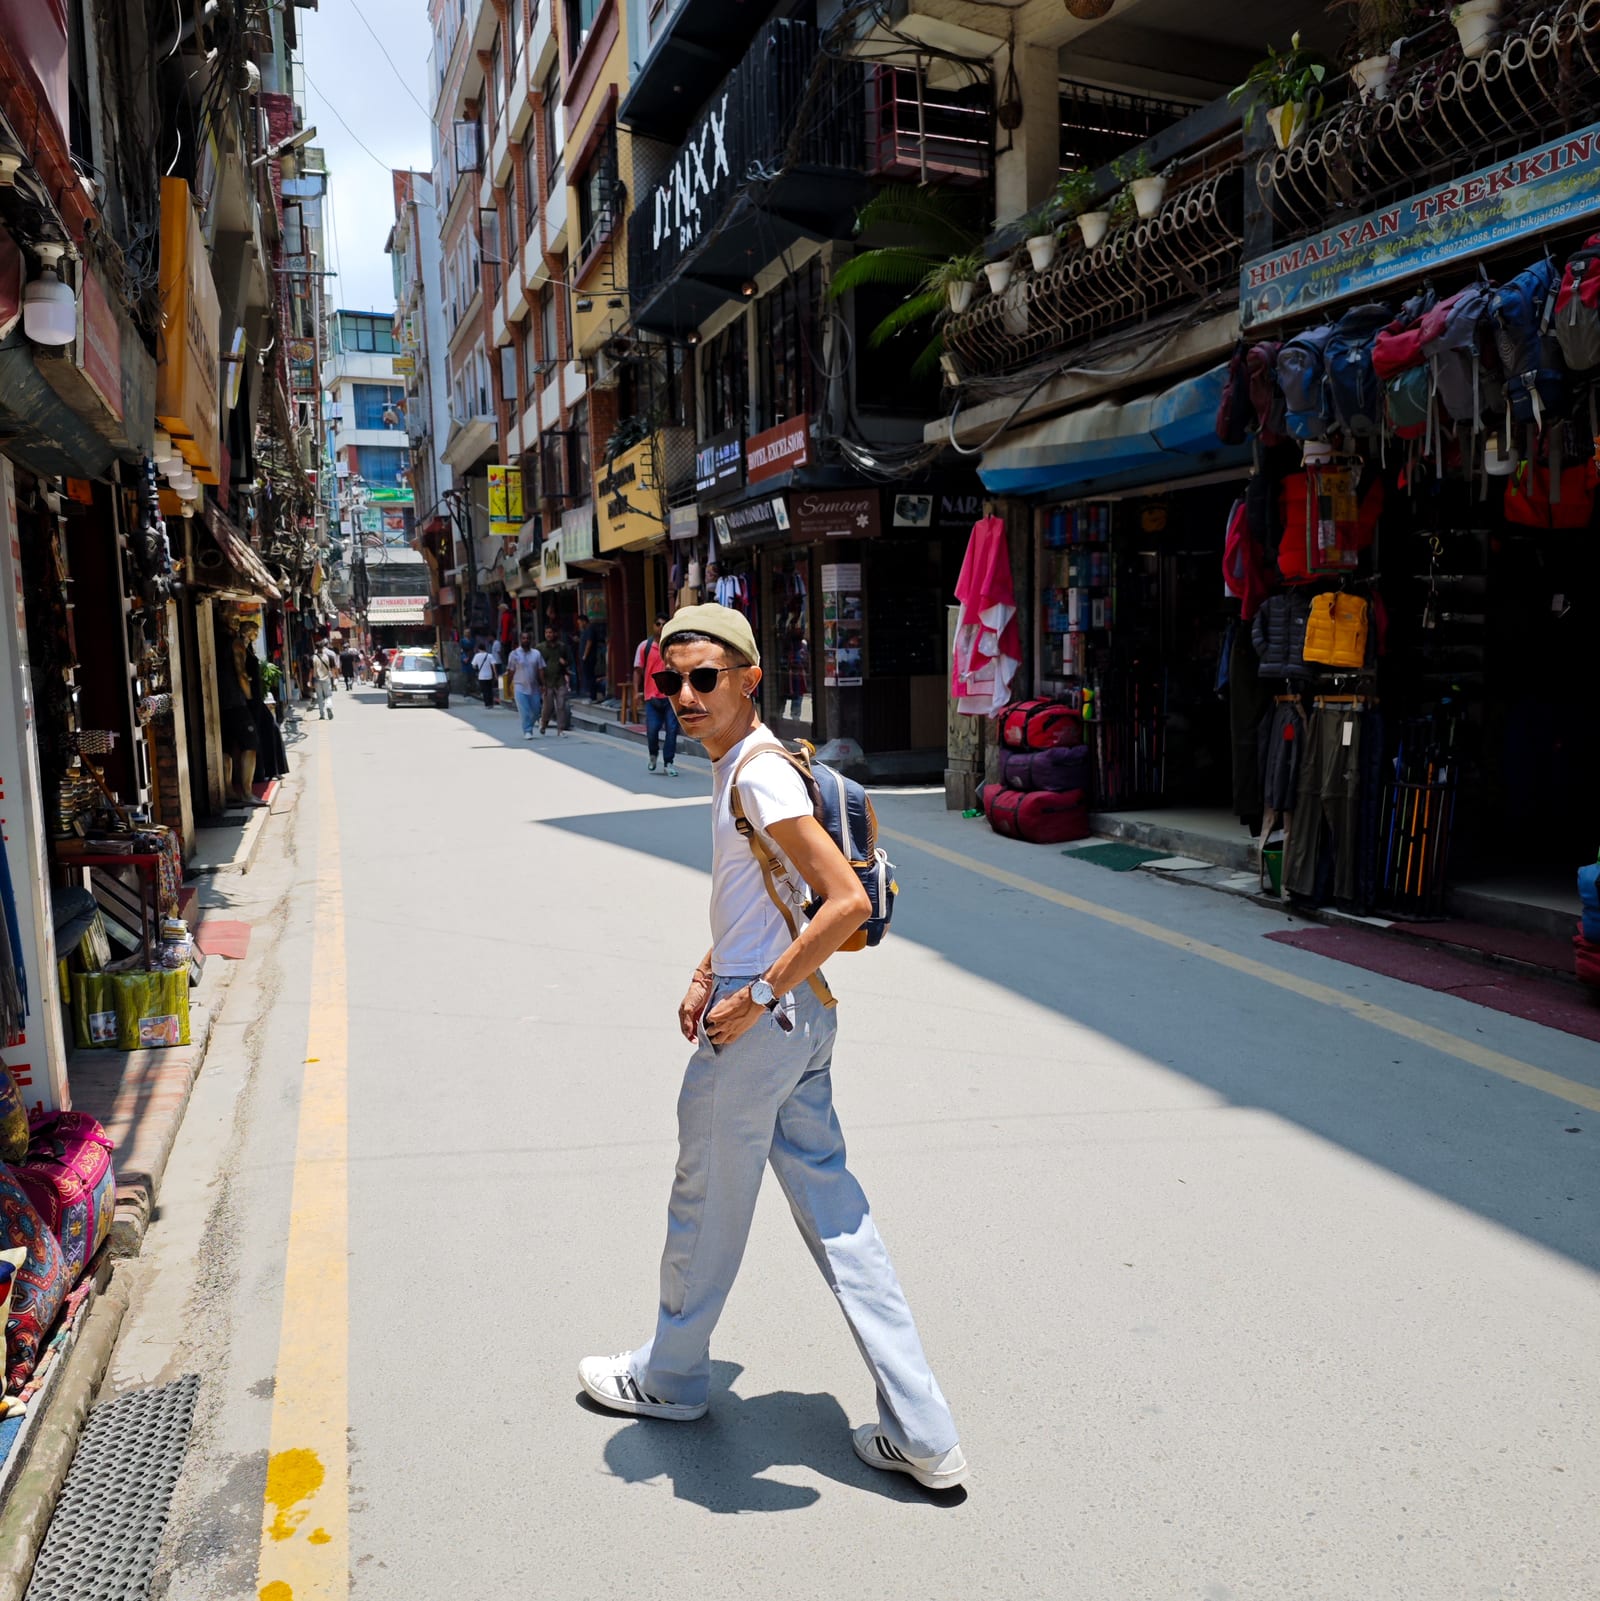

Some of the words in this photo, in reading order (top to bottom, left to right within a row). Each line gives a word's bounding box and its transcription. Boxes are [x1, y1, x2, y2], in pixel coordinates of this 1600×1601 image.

[679, 207, 702, 253] BAR
[1248, 209, 1401, 290] HIMALYAN
[1411, 131, 1600, 224] TREKKIN
[747, 447, 768, 471] HOTEL
[767, 430, 805, 463] EXCELSIOR
[797, 495, 871, 518] Samaya
